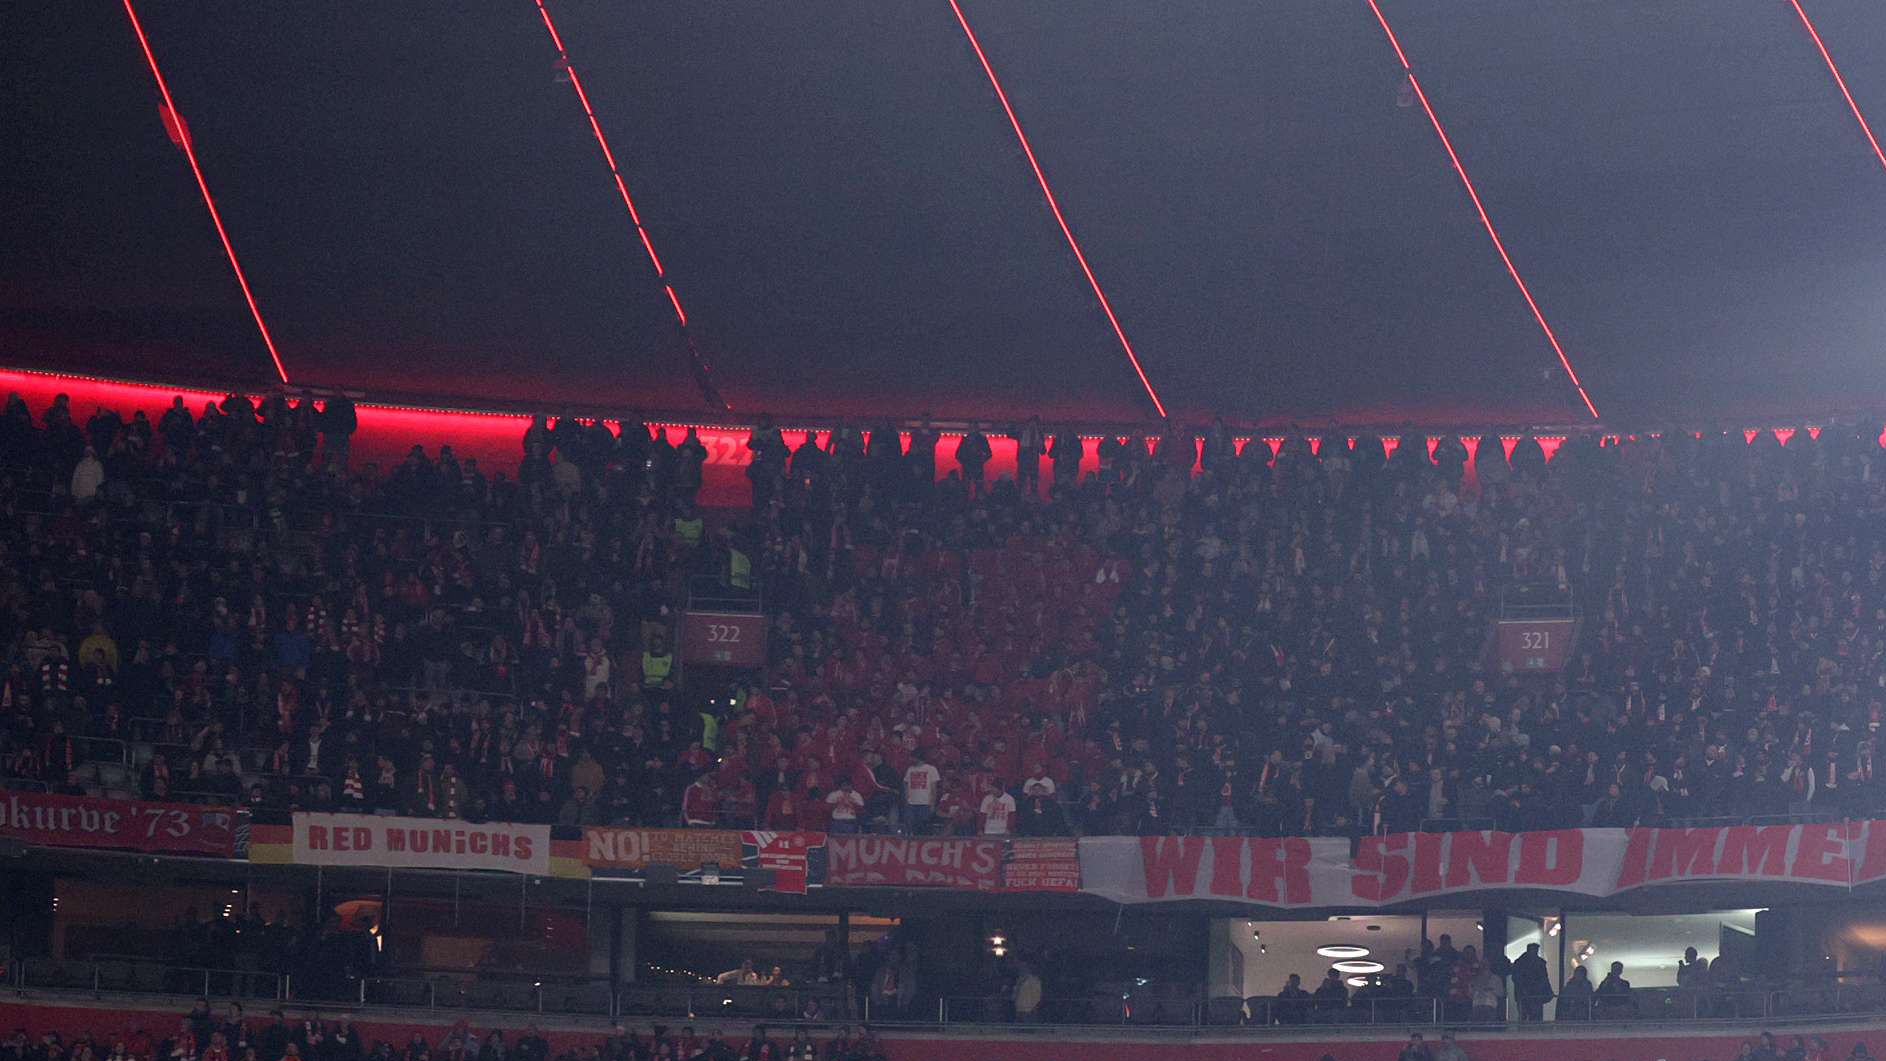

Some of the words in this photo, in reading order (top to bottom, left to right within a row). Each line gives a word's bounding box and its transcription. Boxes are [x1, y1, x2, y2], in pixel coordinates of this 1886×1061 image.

[707, 624, 741, 643] 322
[1521, 631, 1550, 650] 321
[0, 796, 121, 834] kurve
[131, 806, 192, 839] '73
[308, 824, 372, 850] RED
[588, 831, 651, 861] NO!
[1139, 834, 1312, 904] WIR
[1352, 828, 1584, 902] SIND
